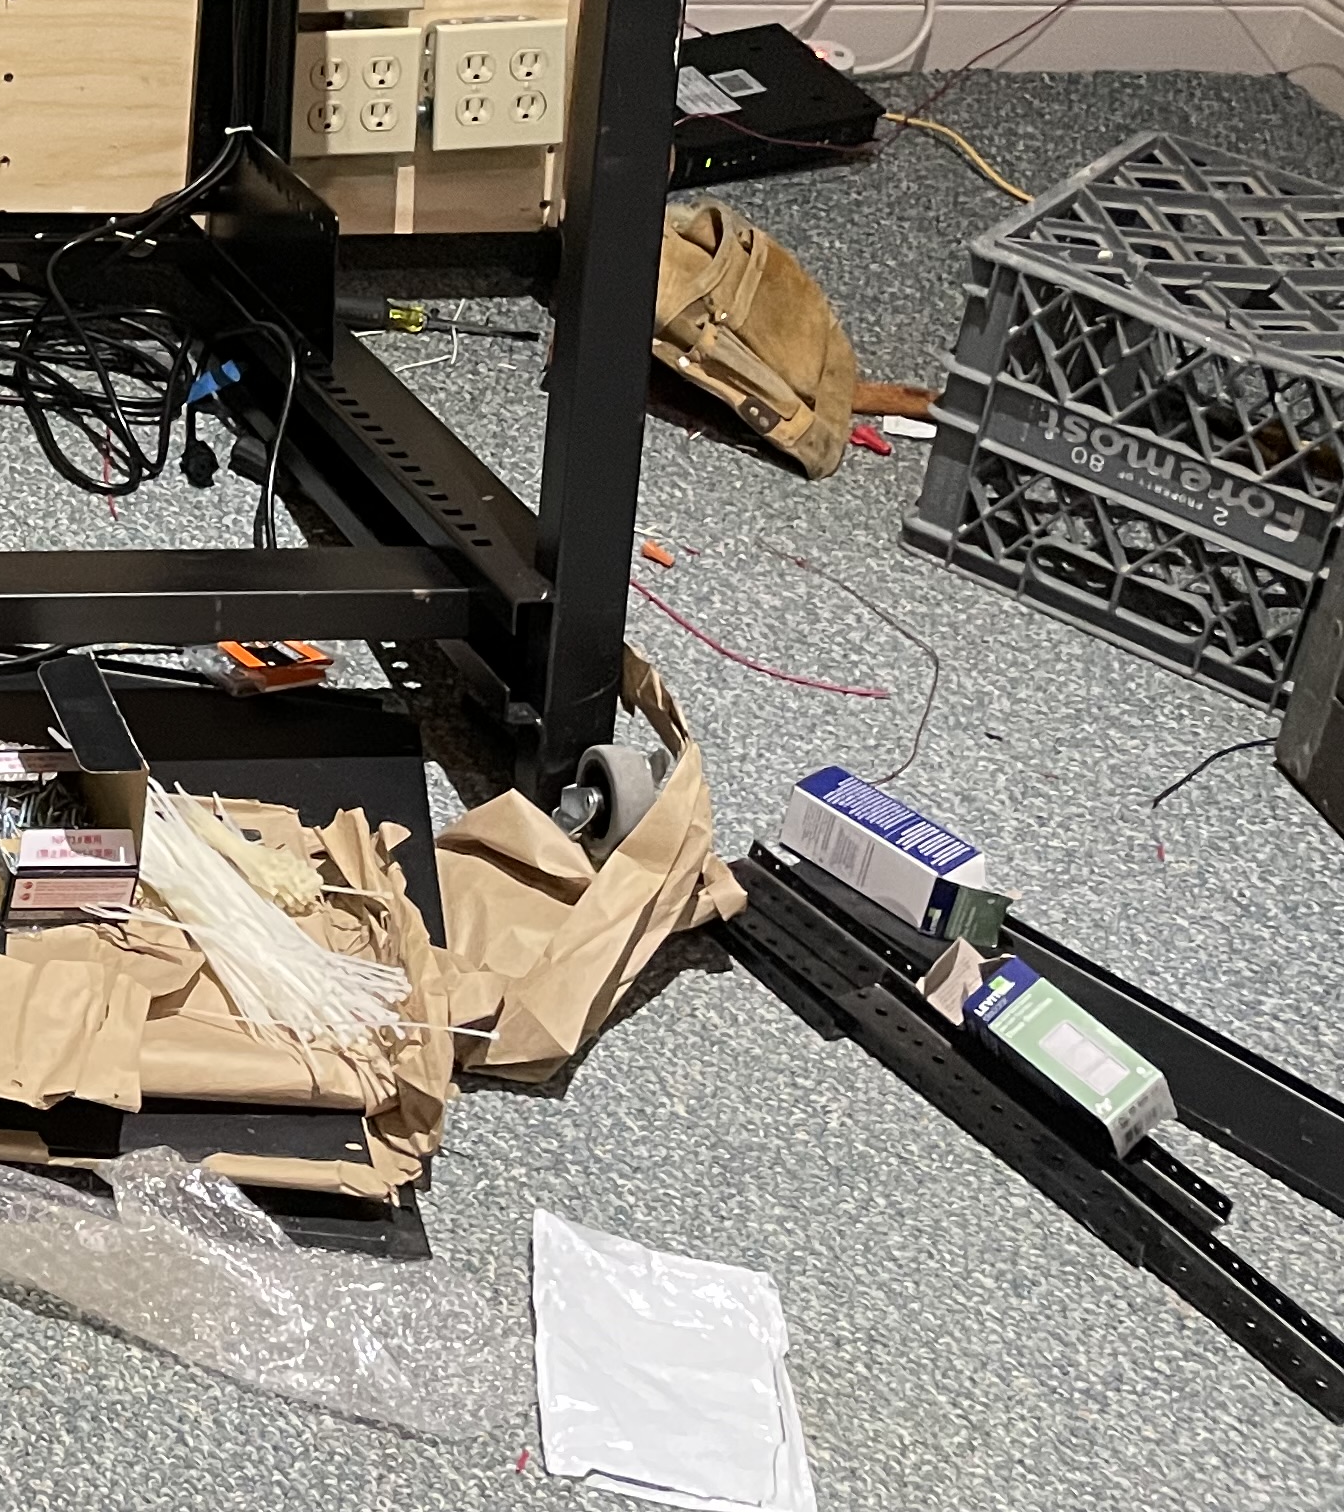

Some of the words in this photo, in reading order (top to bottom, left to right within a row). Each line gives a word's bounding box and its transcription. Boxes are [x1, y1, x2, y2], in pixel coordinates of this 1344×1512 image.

[1071, 446, 1105, 473] 80
[1038, 407, 1305, 542] Foremost
[1118, 471, 1134, 482] OF
[1139, 477, 1203, 510] PROPERTY
[1213, 506, 1229, 526] 2
